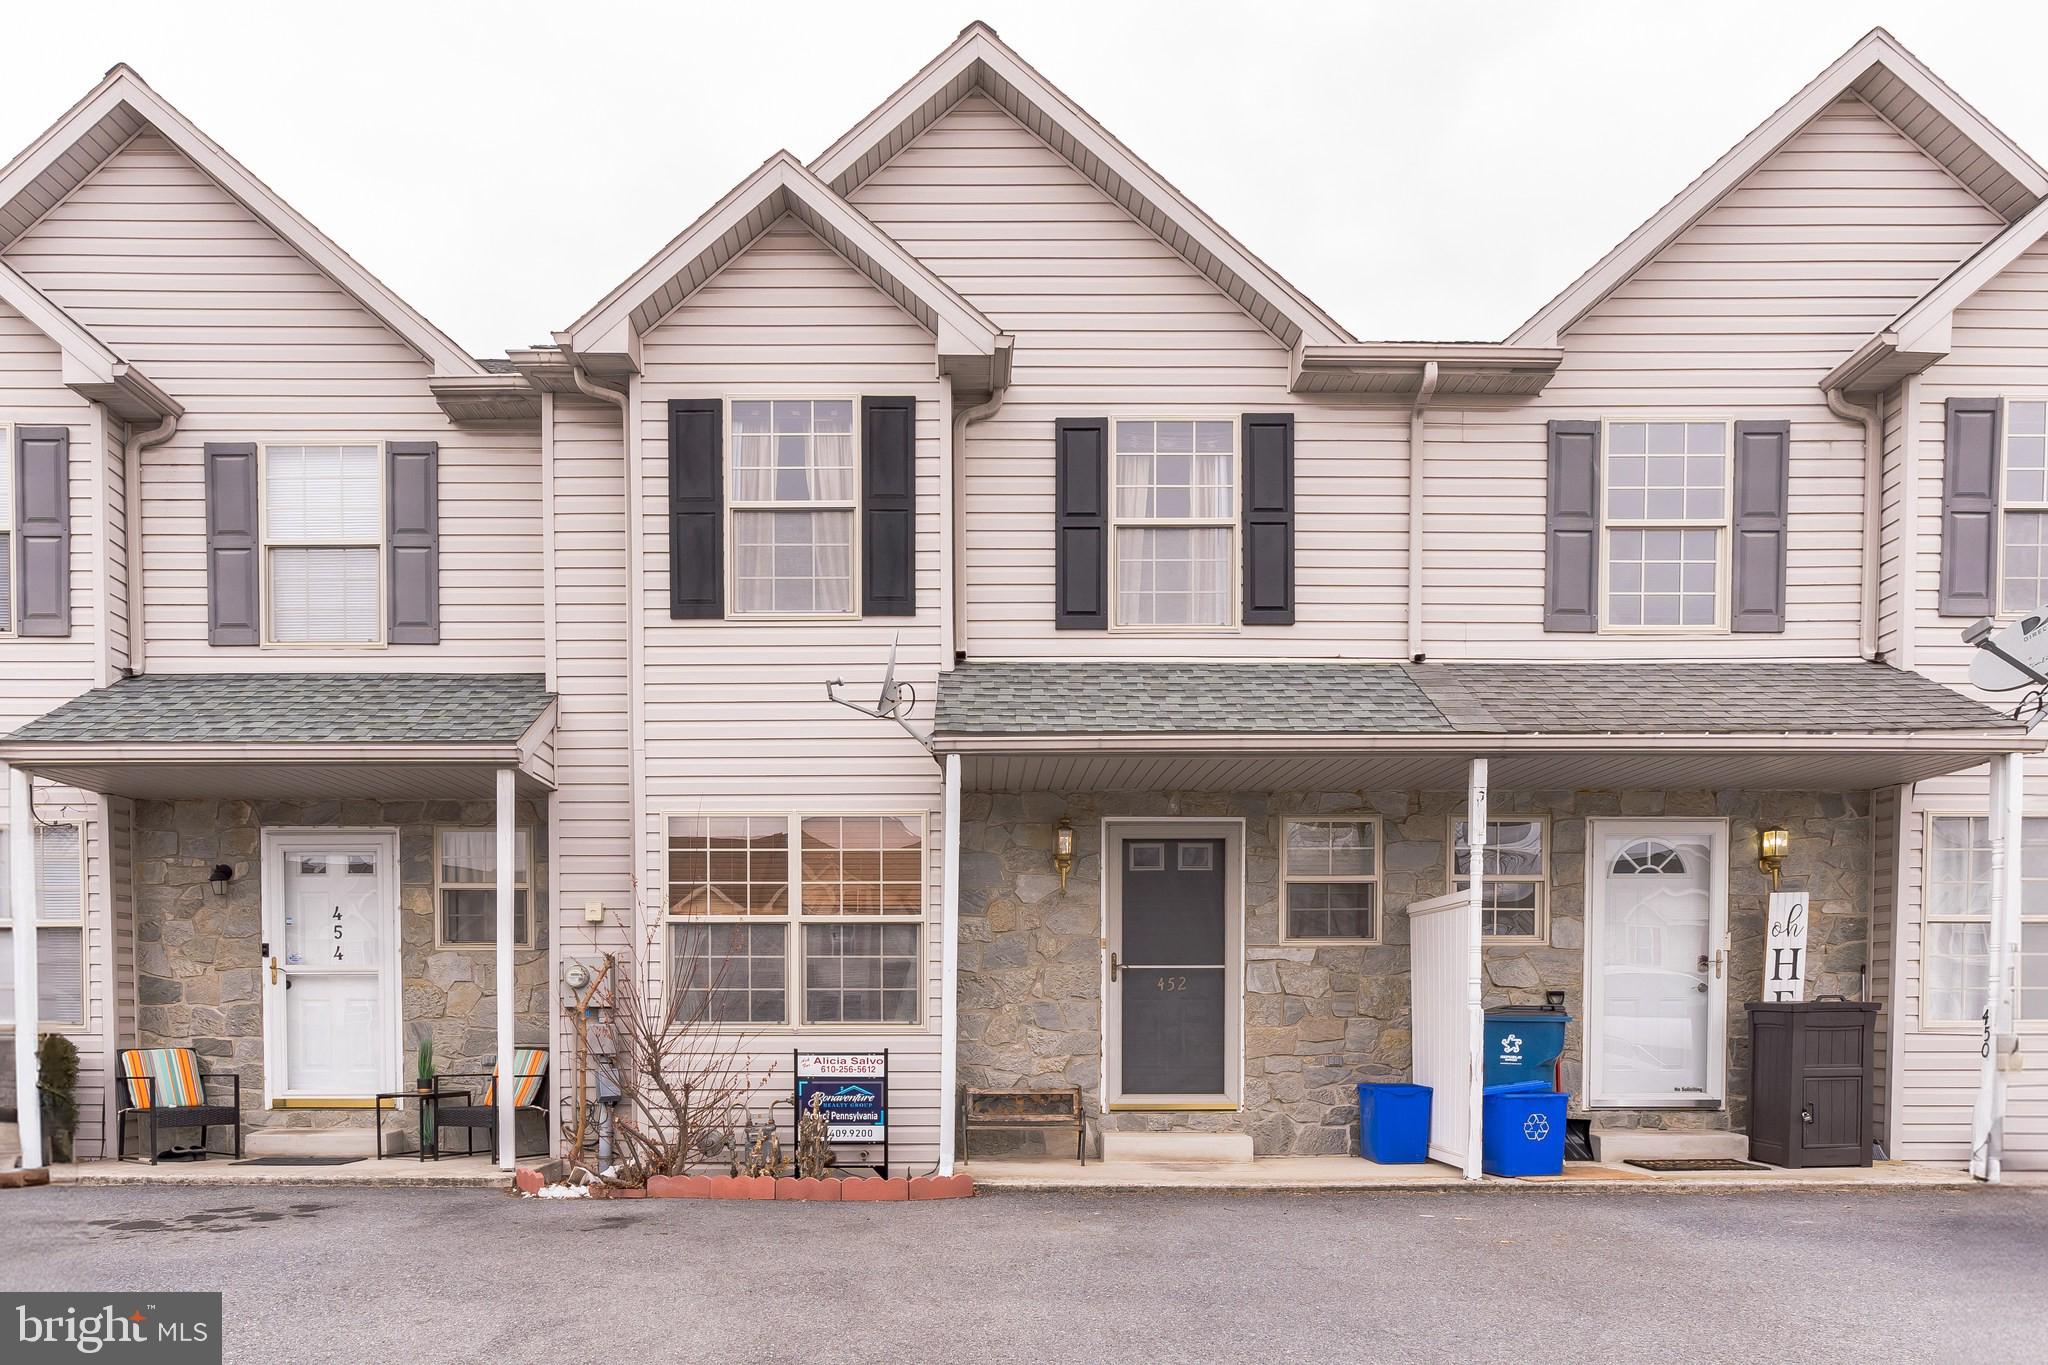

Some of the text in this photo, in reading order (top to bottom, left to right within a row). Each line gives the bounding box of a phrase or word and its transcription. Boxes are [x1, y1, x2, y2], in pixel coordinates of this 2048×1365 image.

[1771, 903, 1805, 937] oh
[332, 905, 344, 961] 454
[1157, 976, 1187, 992] 452
[1981, 1008, 1991, 1058] 450
[813, 1056, 884, 1065] Alicia Salvo
[820, 1065, 877, 1073] 610-256-5612
[808, 1091, 875, 1107] Bonaventure
[830, 1111, 878, 1122] Pennsylvania
